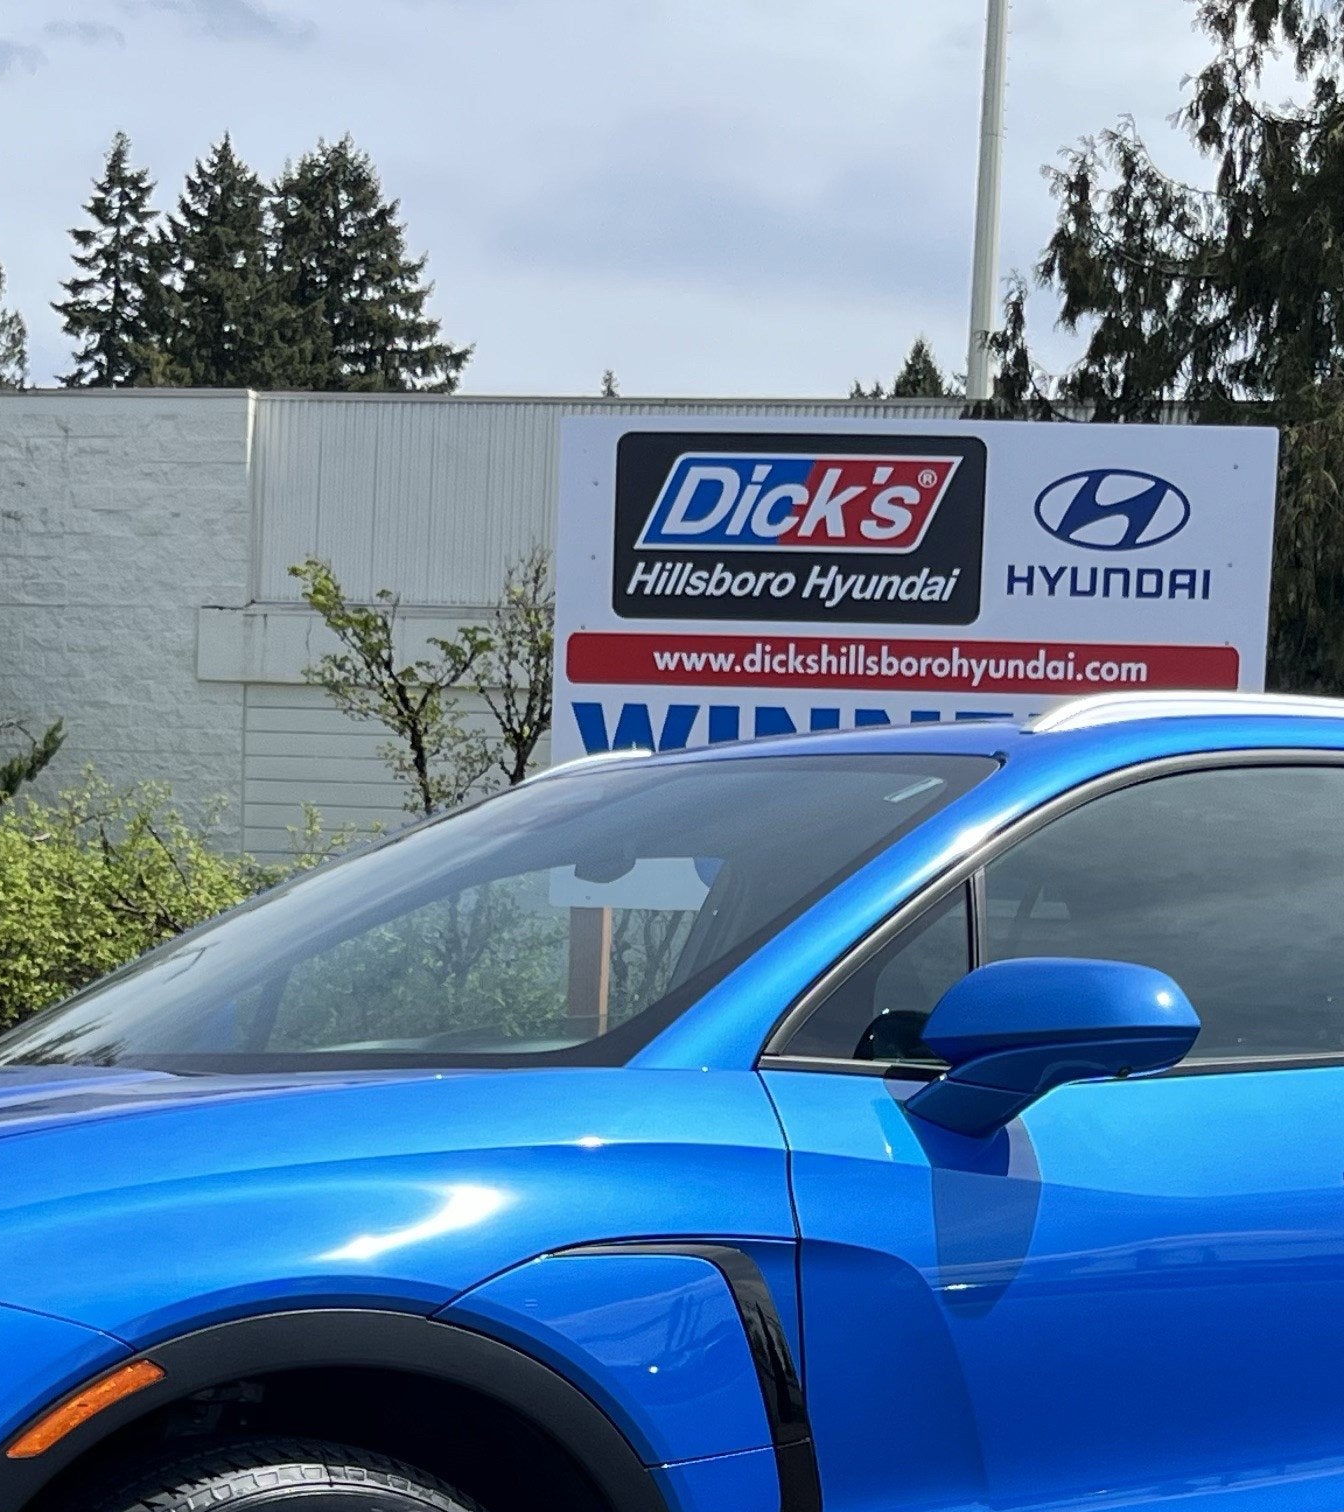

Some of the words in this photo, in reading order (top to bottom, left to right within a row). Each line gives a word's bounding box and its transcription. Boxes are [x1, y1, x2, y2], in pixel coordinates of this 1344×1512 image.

[660, 461, 922, 543] Dick's
[626, 561, 795, 598] Hillsboro
[801, 566, 961, 608] Hyundai
[1006, 565, 1211, 600] HYUNDAI
[653, 642, 1148, 686] www.dickshillsborohyundai.com
